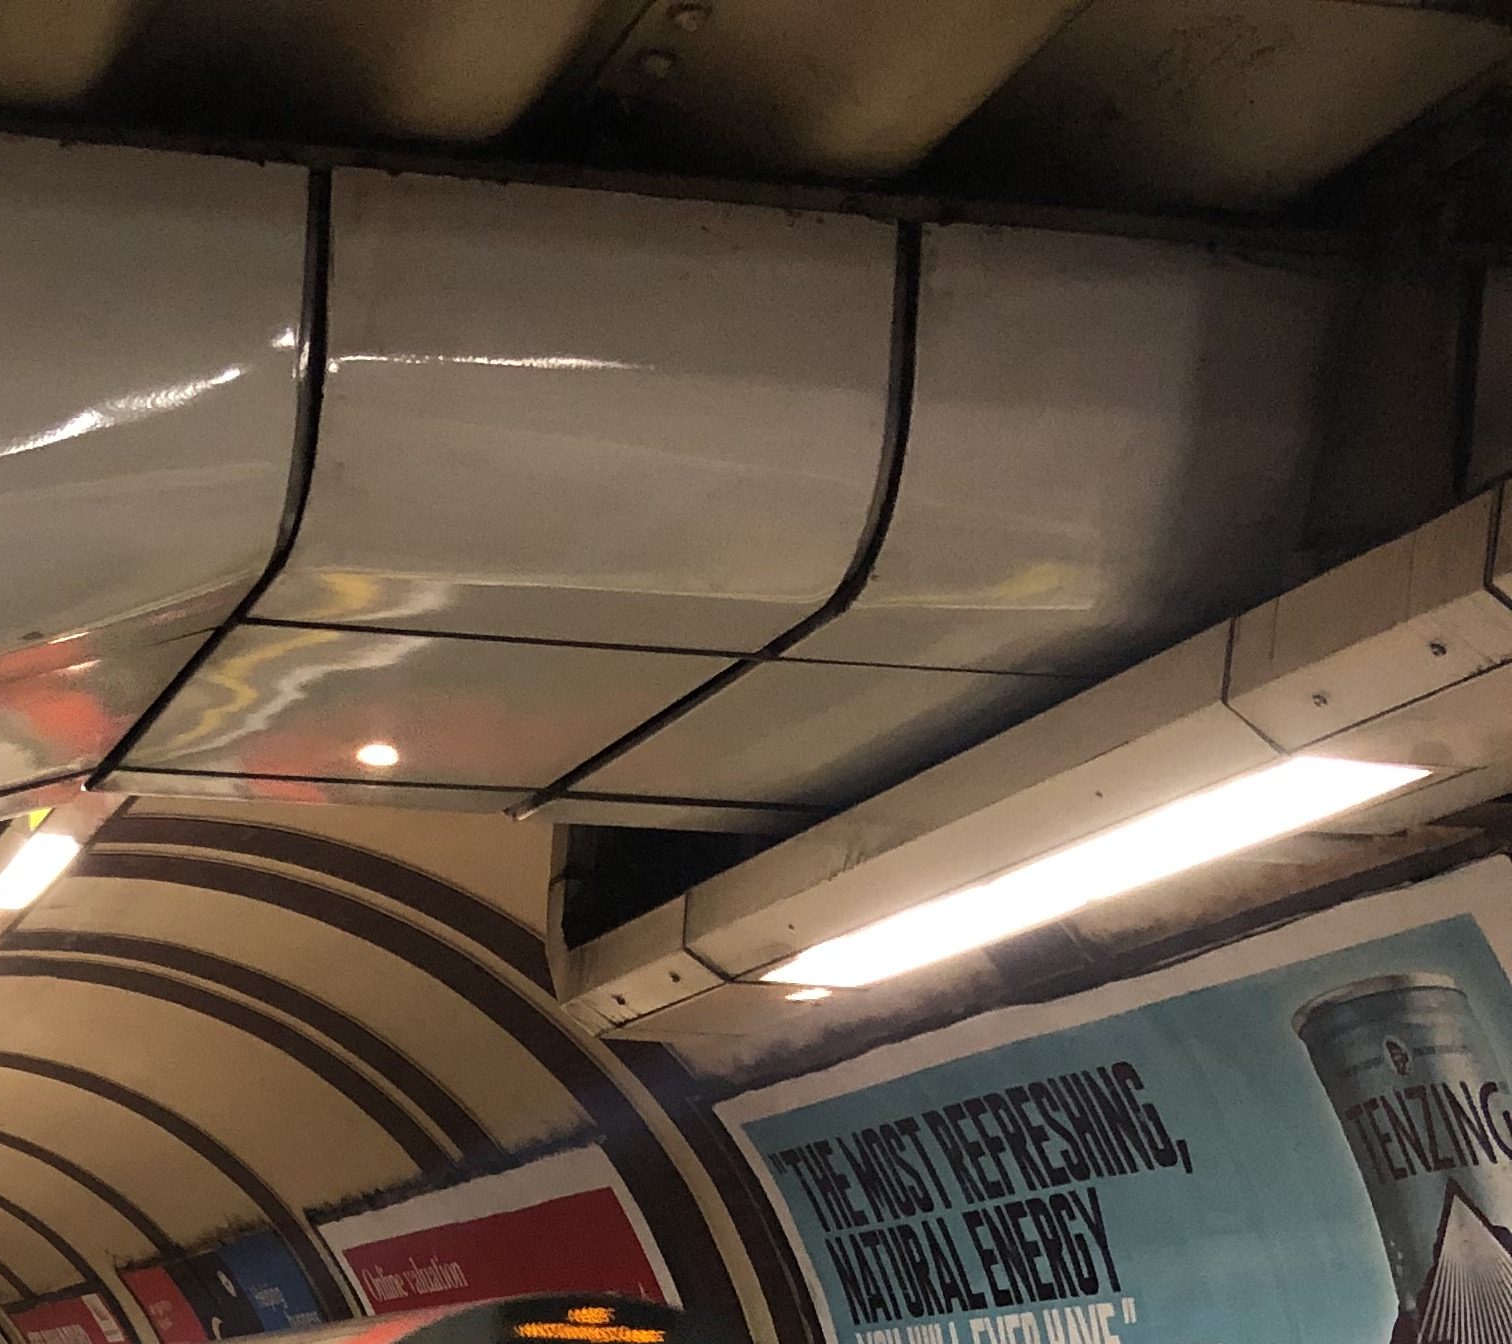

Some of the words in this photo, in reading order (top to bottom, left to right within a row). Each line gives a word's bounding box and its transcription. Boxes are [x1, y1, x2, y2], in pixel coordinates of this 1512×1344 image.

[837, 1116, 952, 1223] MOST
[922, 1061, 1194, 1205] REFRESHING,
[1344, 1080, 1512, 1184] TENZING
[361, 1264, 409, 1302] Online
[403, 1255, 469, 1295] valuation
[824, 1217, 986, 1325] NATURAL
[962, 1187, 1122, 1307] ENERGY
